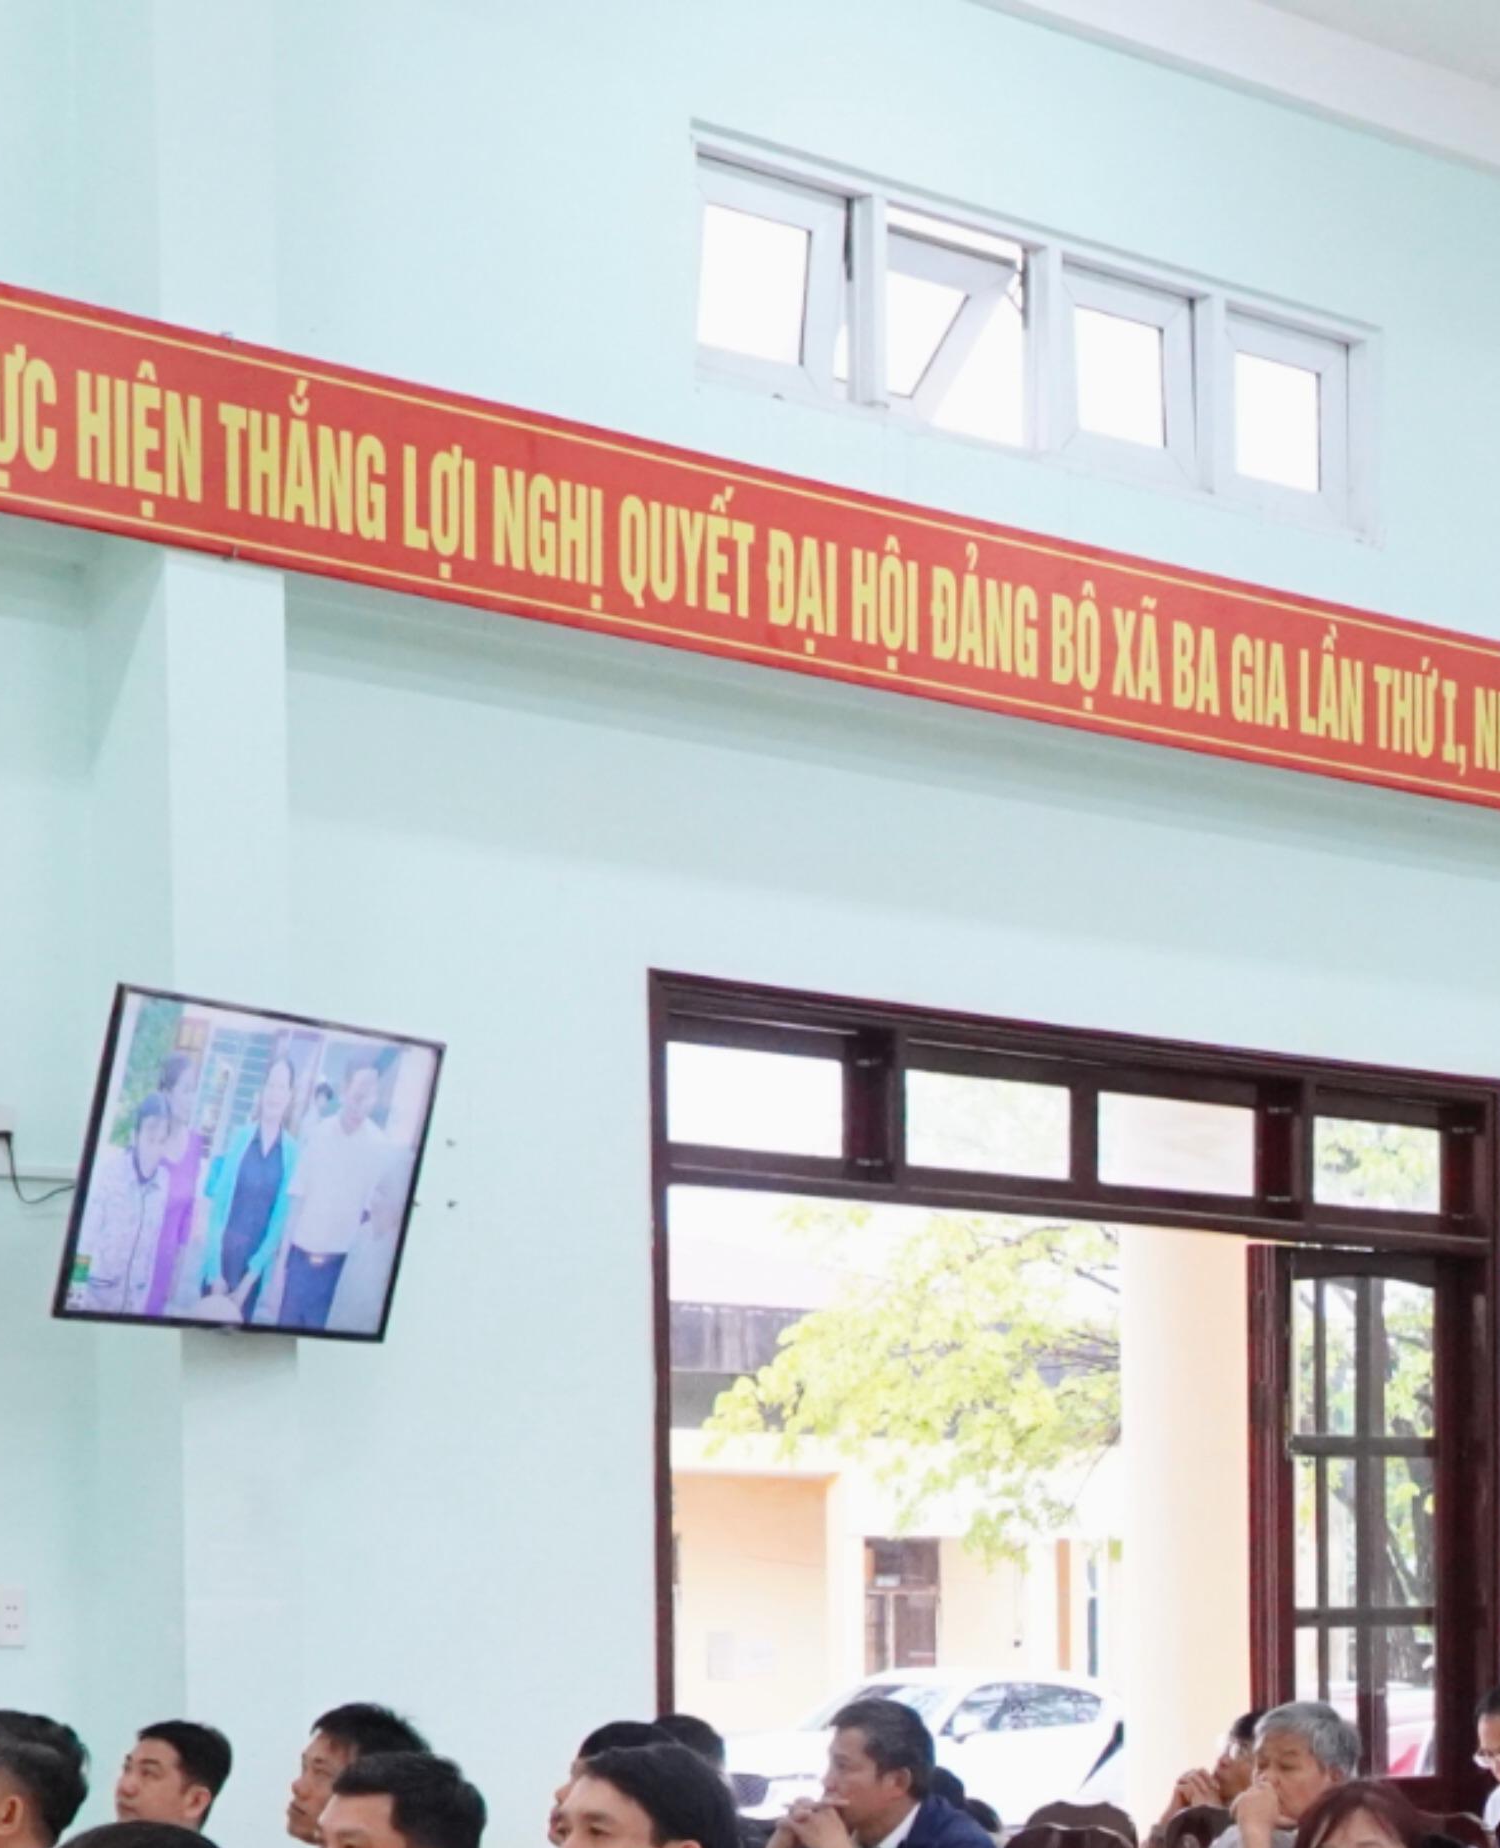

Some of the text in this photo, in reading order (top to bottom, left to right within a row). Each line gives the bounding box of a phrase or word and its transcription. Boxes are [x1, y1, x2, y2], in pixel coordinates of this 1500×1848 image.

[76, 360, 204, 518] HIỆN
[218, 378, 388, 542] THẮNG
[402, 444, 478, 580] LỢI
[493, 466, 604, 611] NGHỊ
[618, 486, 756, 620] QUYẾT
[766, 528, 839, 656] ĐẠI
[851, 538, 920, 671] HỘI
[930, 542, 1038, 680] ĐẢNG
[1051, 580, 1102, 711] BỘ
[1112, 596, 1162, 706] XÃ
[1171, 620, 1222, 717] BA
[1230, 634, 1291, 732] GIA
[1300, 624, 1365, 746] LẦN
[1373, 663, 1440, 759] THỨ
[1442, 680, 1467, 776] I,
